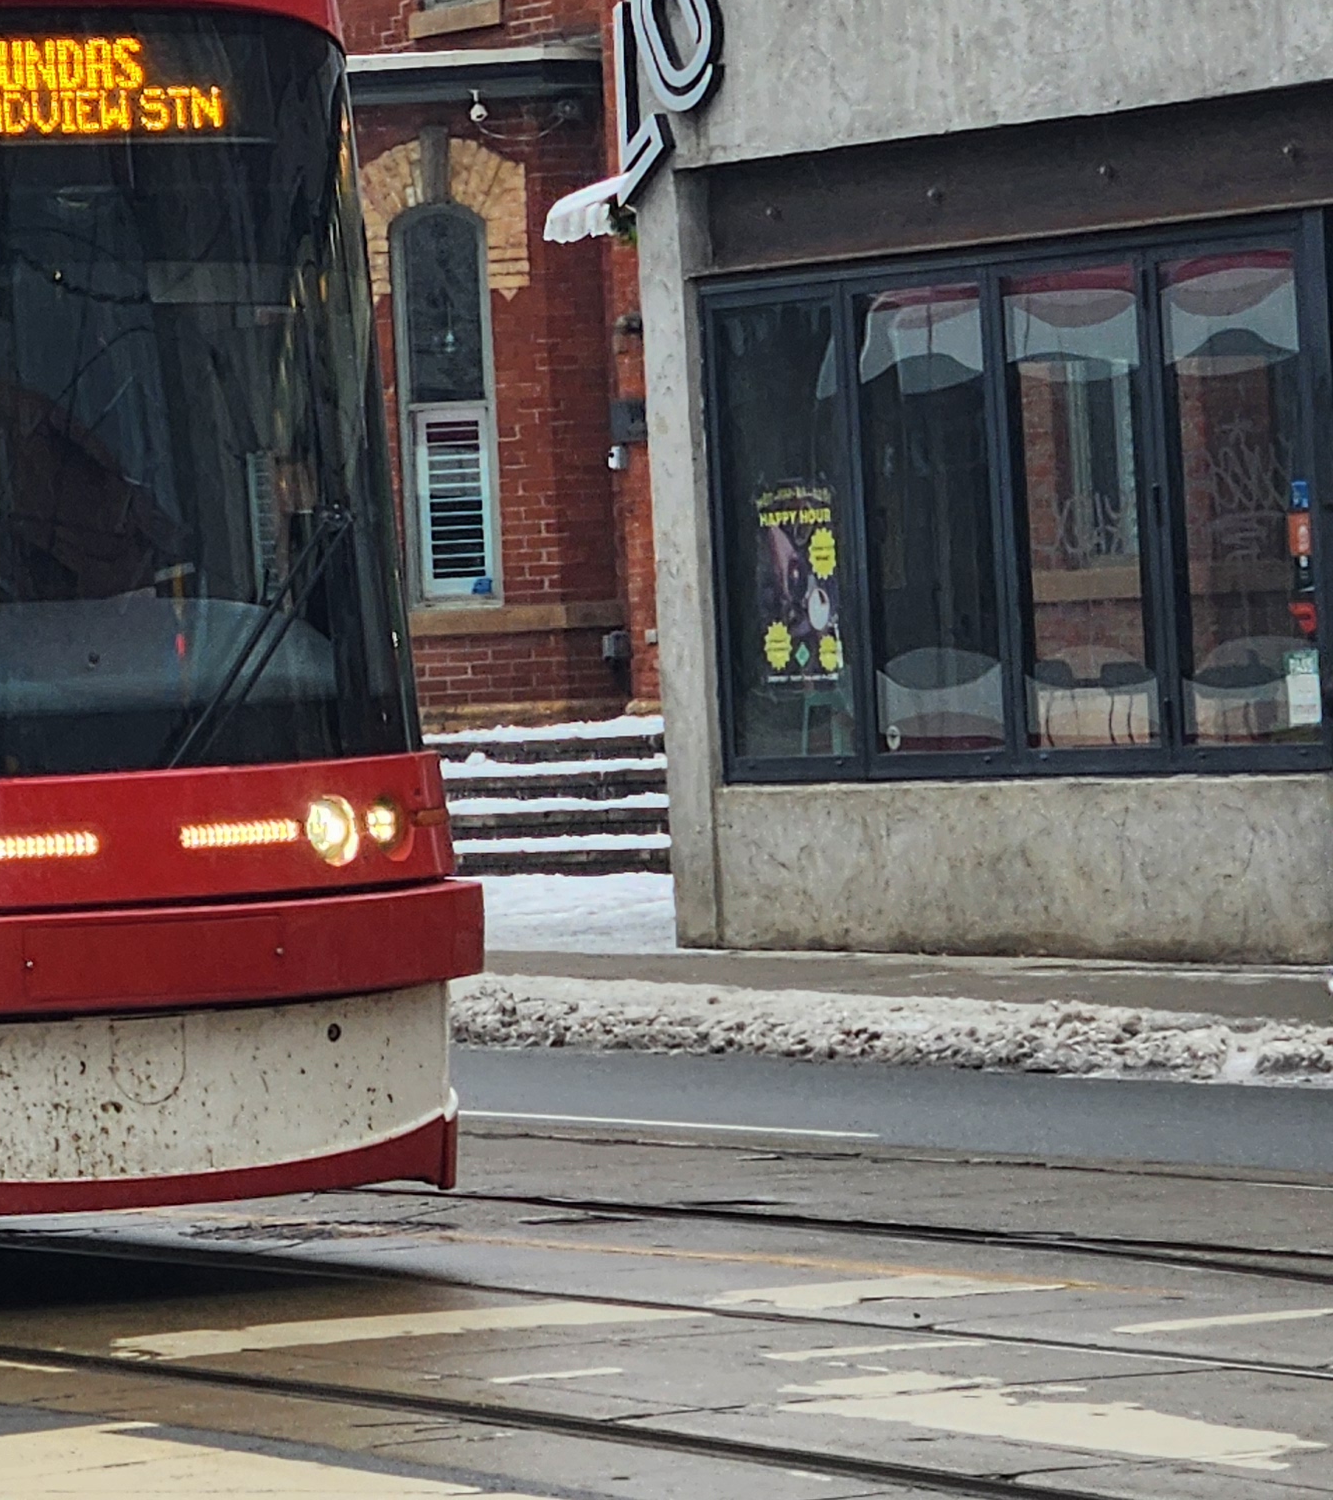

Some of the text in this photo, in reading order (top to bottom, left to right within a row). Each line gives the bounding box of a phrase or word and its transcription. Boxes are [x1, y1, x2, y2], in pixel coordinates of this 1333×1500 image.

[138, 85, 223, 132] STN
[759, 507, 832, 528] HAPPY HOUR
